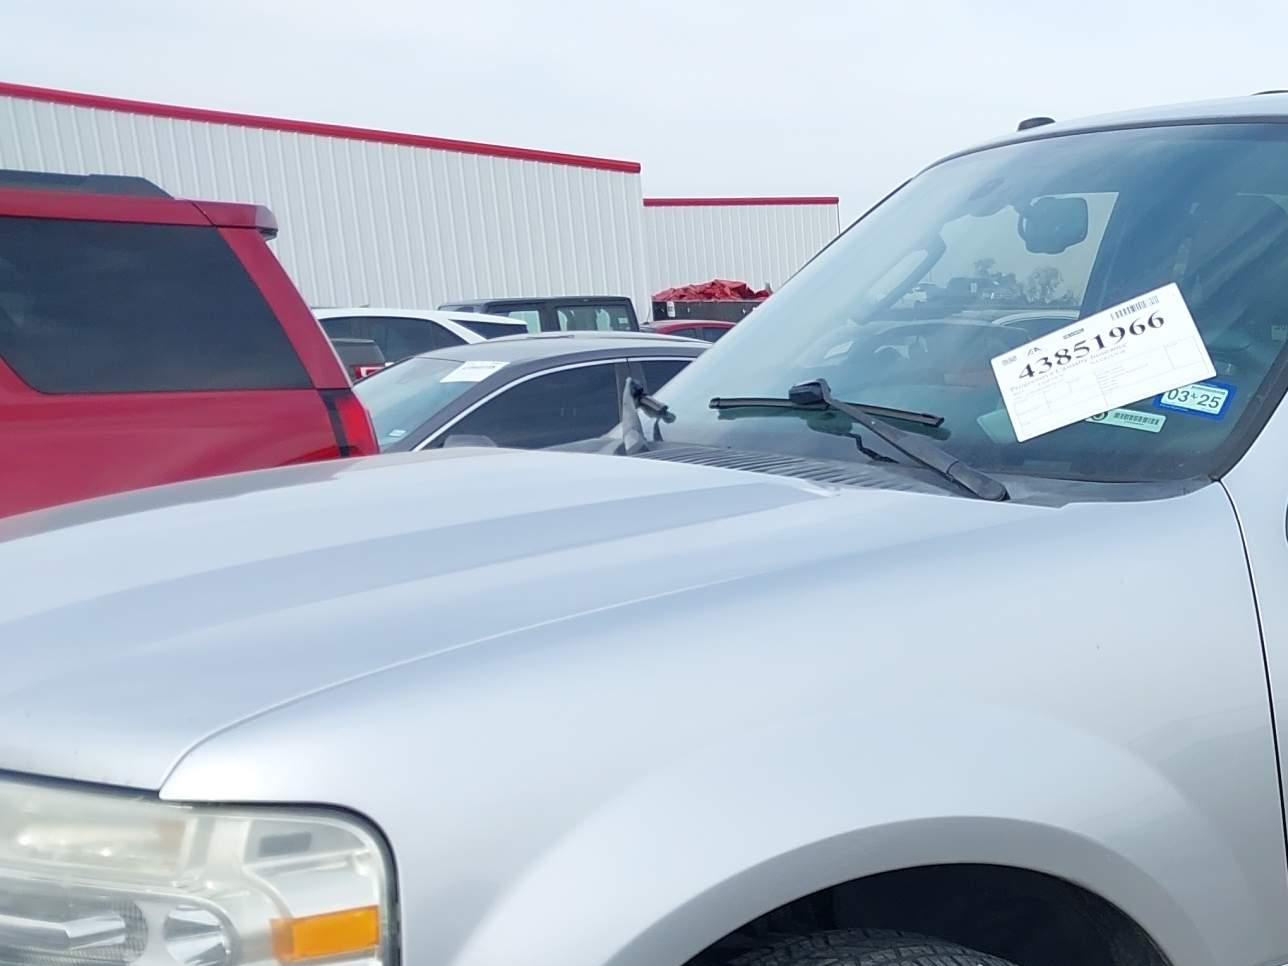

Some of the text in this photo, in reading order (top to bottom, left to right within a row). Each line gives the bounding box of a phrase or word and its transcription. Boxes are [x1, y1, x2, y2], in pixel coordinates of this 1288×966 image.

[1019, 309, 1165, 380] 43851966
[1167, 387, 1191, 403] 03
[1199, 393, 1222, 409] 25
